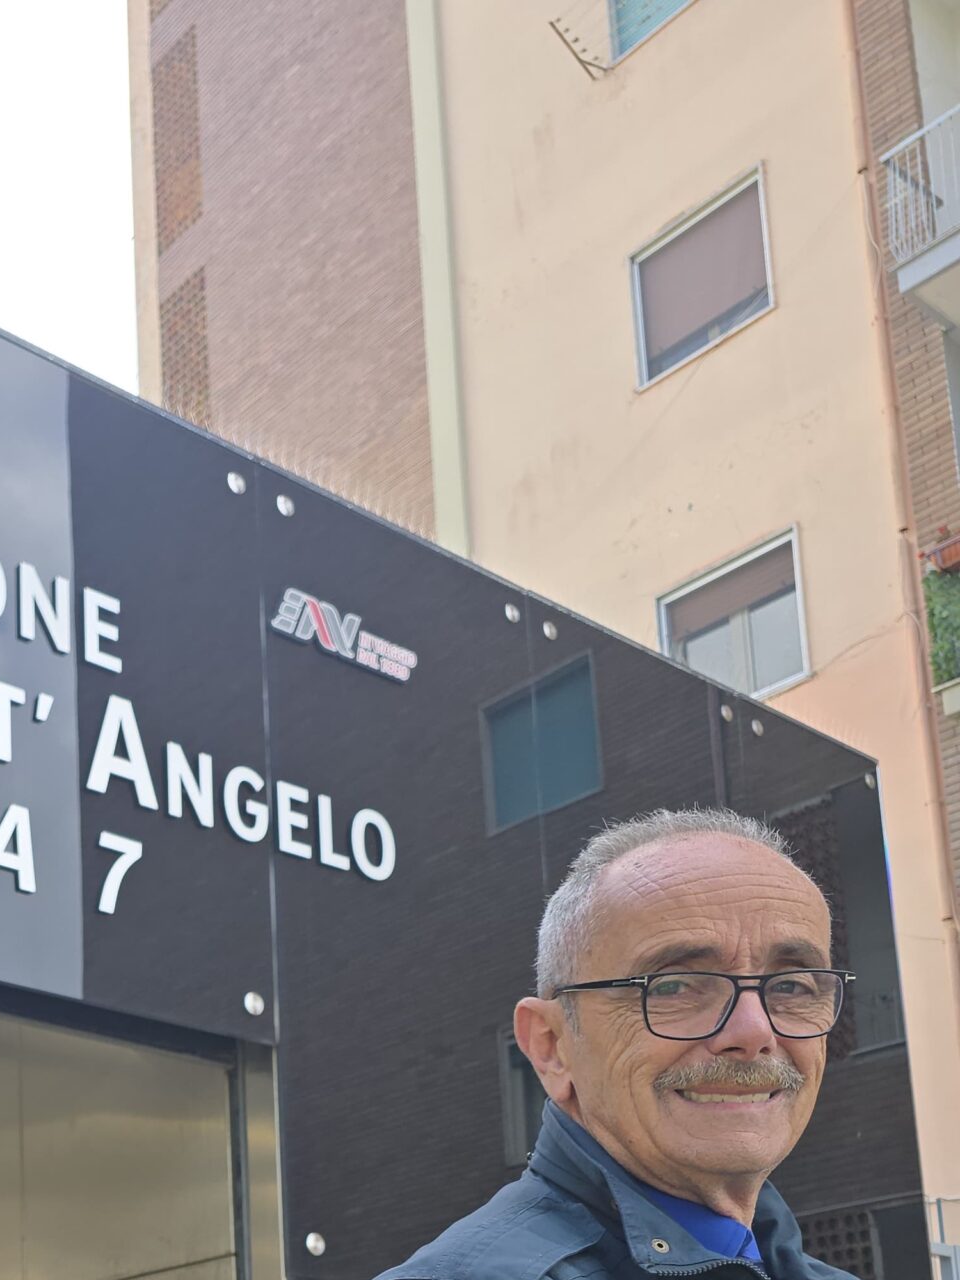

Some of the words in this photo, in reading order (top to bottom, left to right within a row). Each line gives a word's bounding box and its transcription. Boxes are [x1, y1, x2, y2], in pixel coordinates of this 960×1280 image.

[271, 587, 362, 659] EAV
[86, 695, 396, 881] ANGELO
[97, 830, 145, 916] 7
